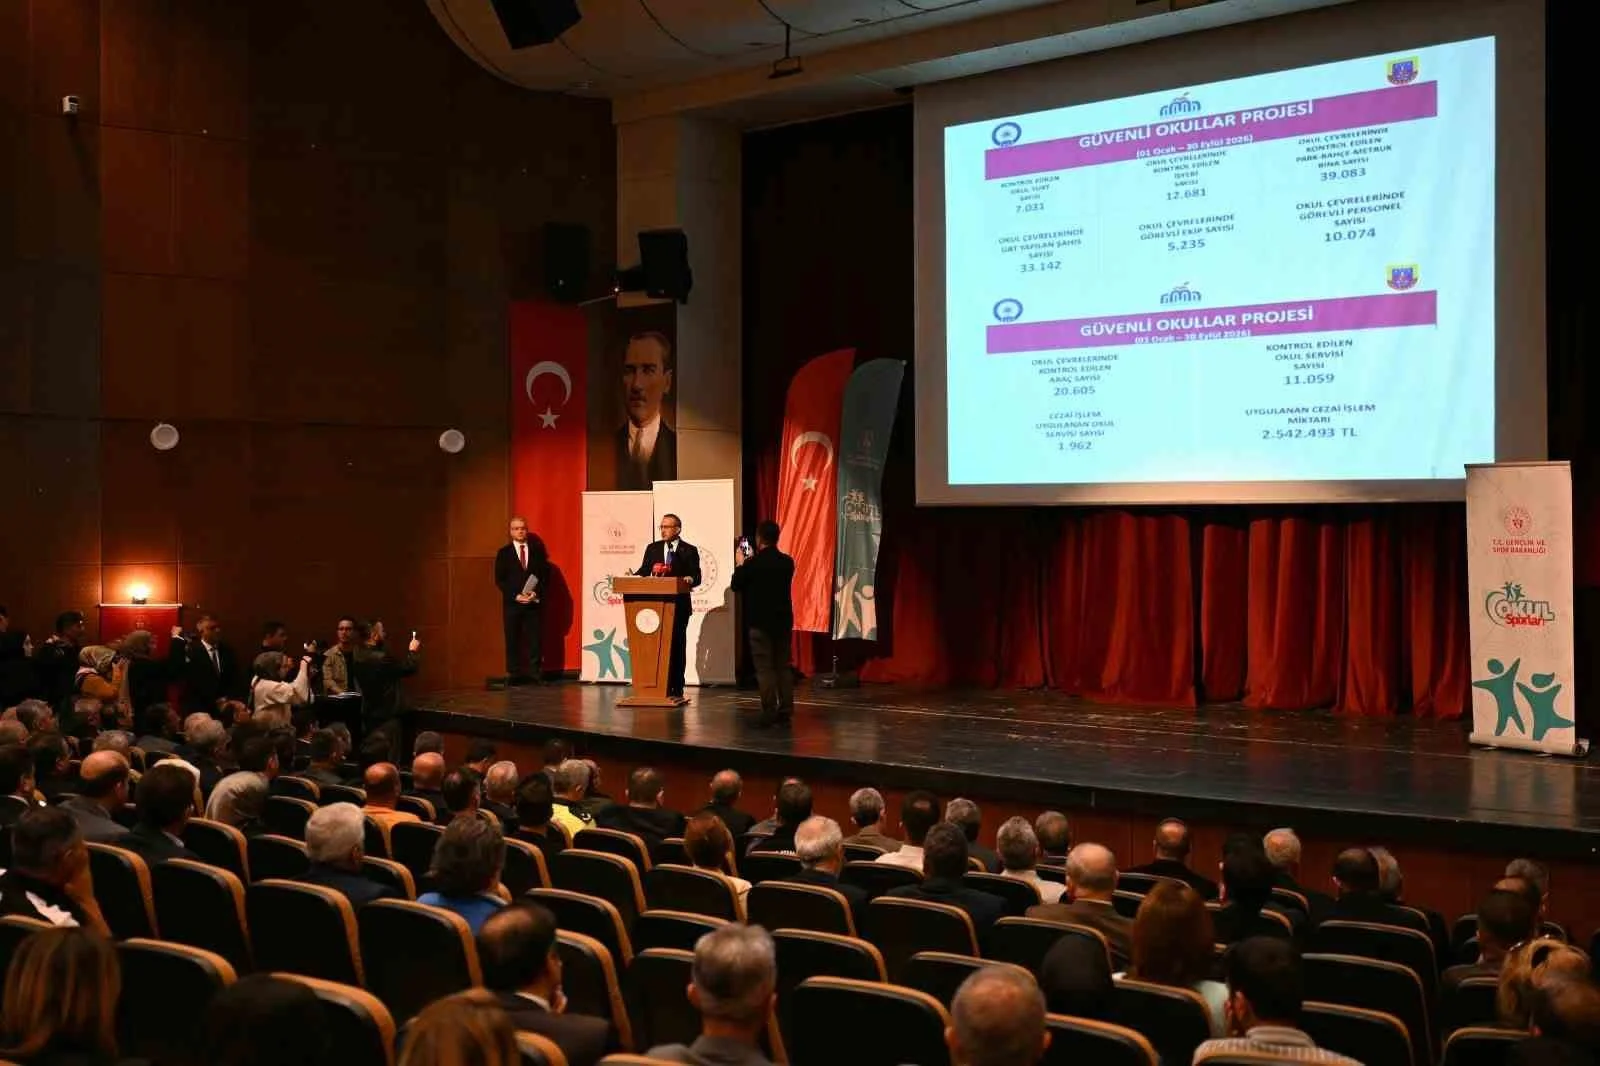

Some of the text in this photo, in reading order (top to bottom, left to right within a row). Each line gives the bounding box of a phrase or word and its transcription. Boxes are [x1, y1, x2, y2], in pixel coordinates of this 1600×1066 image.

[1079, 100, 1313, 149] GÜVENLİ OKULLAR PROJESİ
[1320, 167, 1366, 181] 39.083
[1295, 191, 1406, 210] OKUL ÇEVRELERİNDE
[1299, 202, 1402, 221] GÖREVLİ PERSONEL
[1138, 222, 1163, 231] OKUL
[1205, 223, 1235, 233] SAYISI
[1334, 216, 1366, 227] SAYISI
[1324, 227, 1377, 242] 10.074
[1167, 238, 1206, 251] 5.235
[1020, 260, 1062, 273] 33.142
[1080, 305, 1314, 337] GÜVENLİ OKULLAR PROJESİ
[1266, 339, 1353, 352] KONTROL EDİLEN
[1275, 350, 1344, 361] OKUL SERVİSİ
[1293, 362, 1325, 370] SAYISI
[1285, 373, 1335, 385] 11.059
[1054, 385, 1096, 396] 20.605
[1245, 407, 1310, 416] UYGULANAN
[1343, 403, 1376, 413] İŞLEM
[1287, 416, 1331, 424] MİKTARI
[1262, 427, 1358, 440] 2.542.493 TL
[1059, 441, 1092, 450] 1.962
